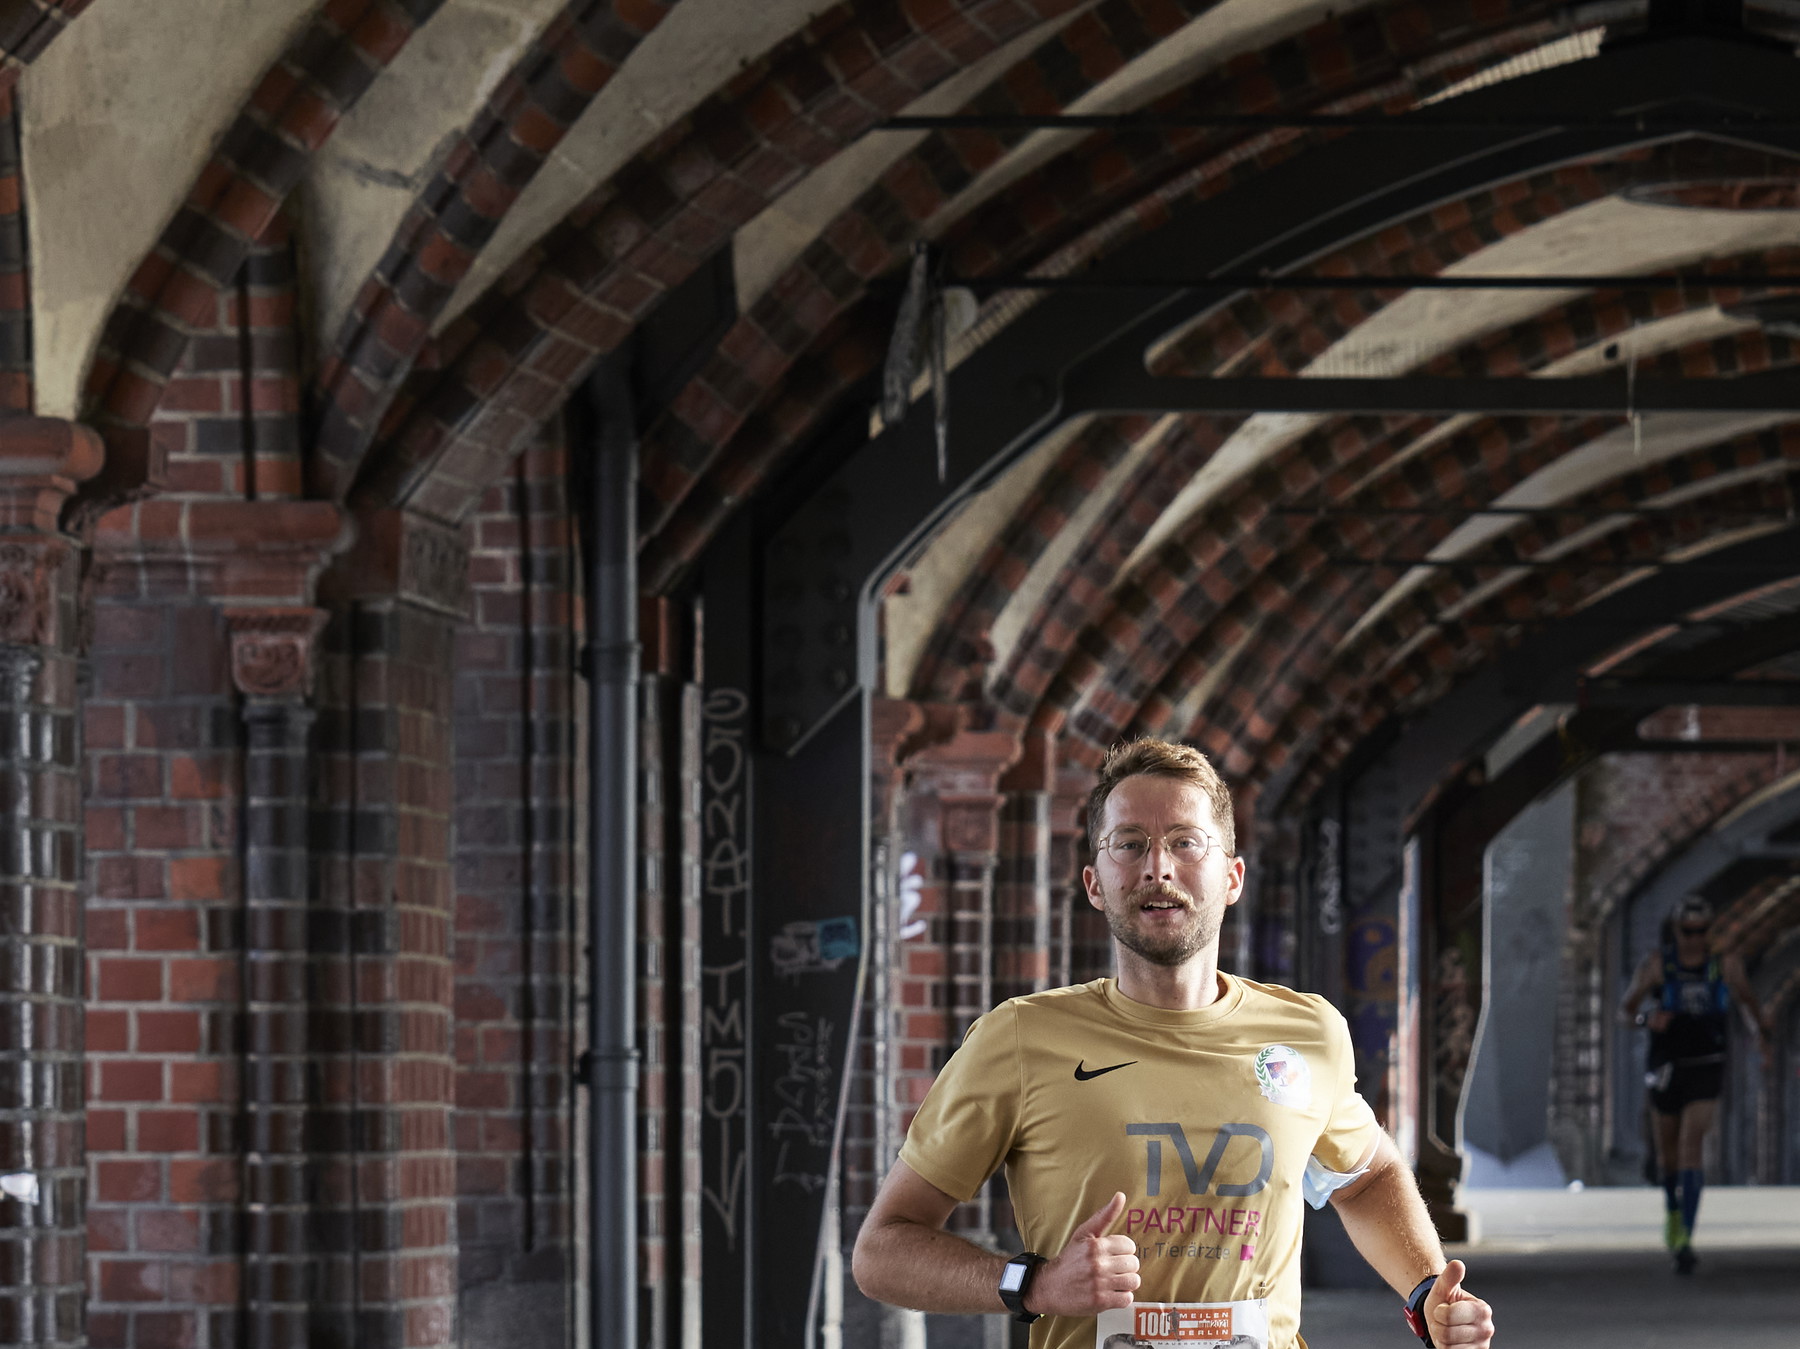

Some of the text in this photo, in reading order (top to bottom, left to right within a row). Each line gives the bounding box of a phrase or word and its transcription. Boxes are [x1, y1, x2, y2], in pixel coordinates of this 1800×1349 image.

[1126, 1122, 1274, 1197] TVD
[1126, 1207, 1262, 1237] PARTNER
[1155, 1241, 1231, 1260] Tierärzte
[1139, 1312, 1170, 1336] 100
